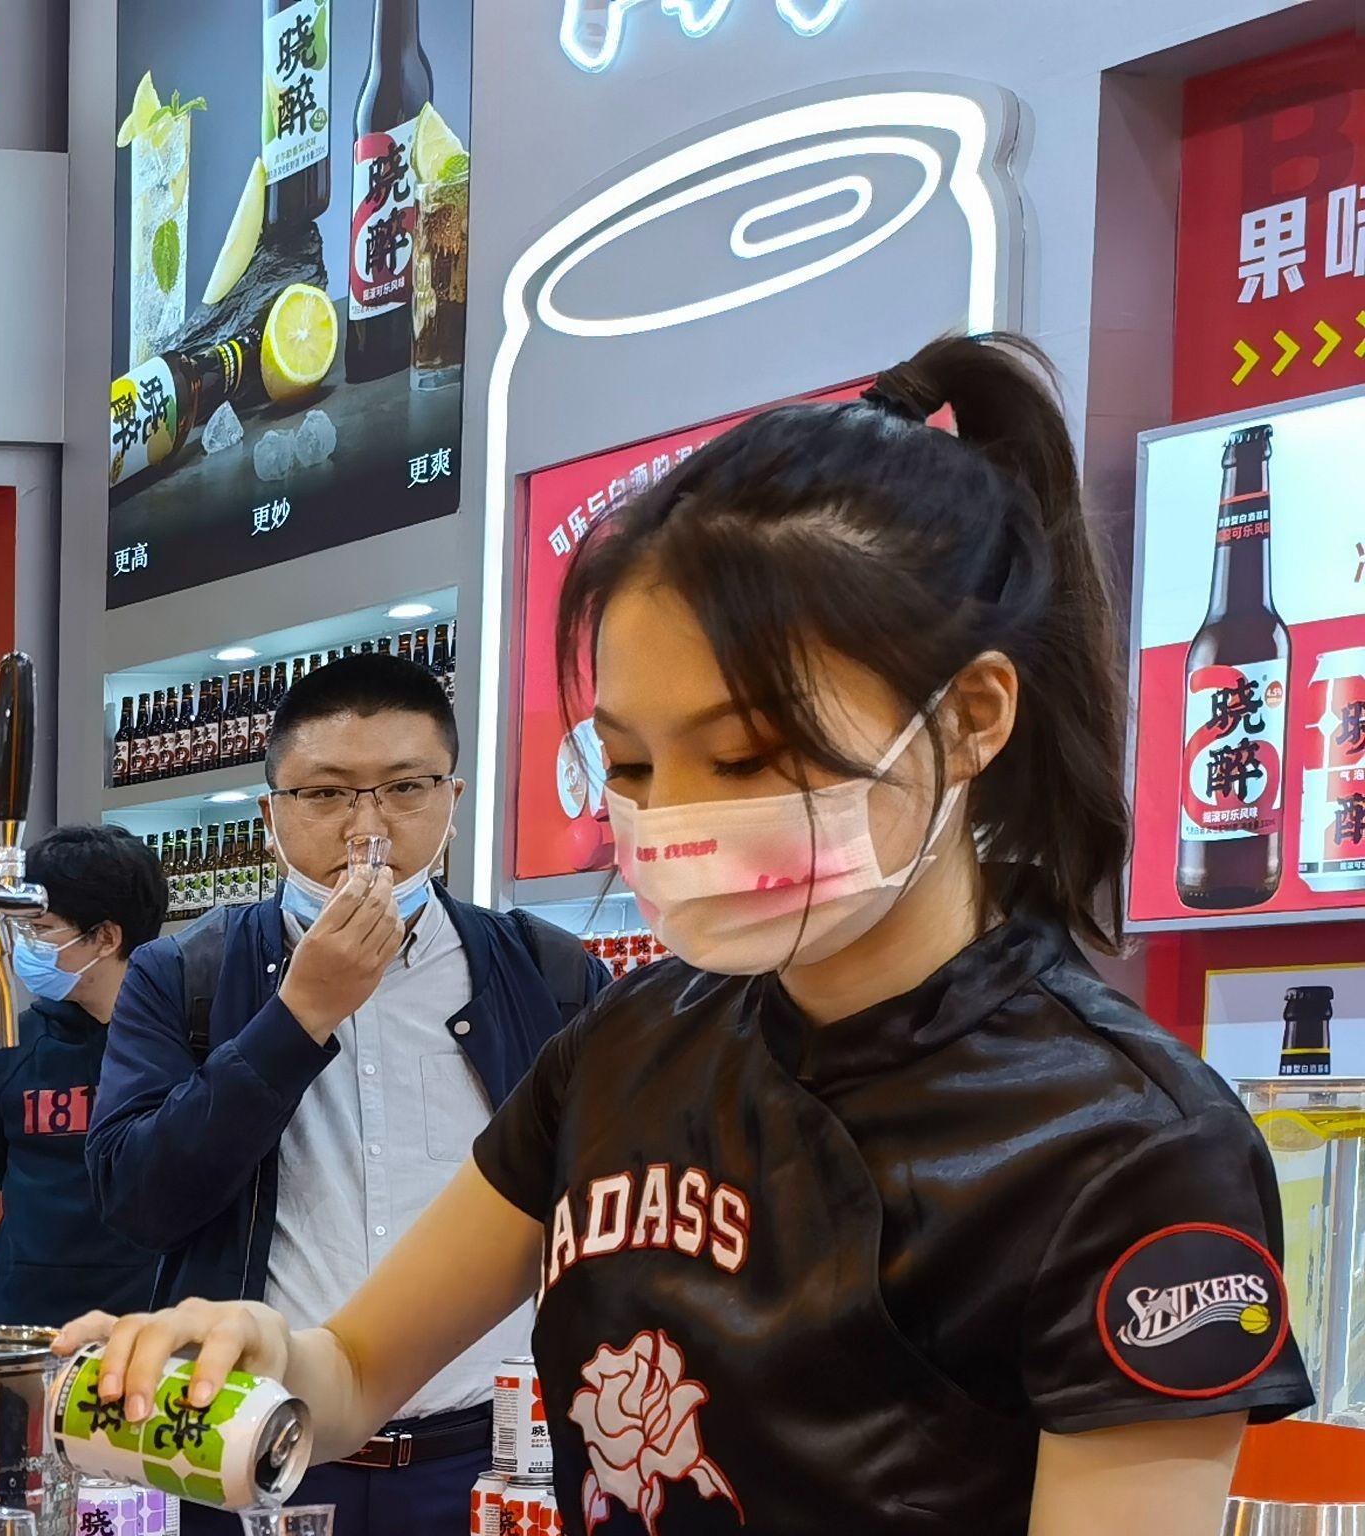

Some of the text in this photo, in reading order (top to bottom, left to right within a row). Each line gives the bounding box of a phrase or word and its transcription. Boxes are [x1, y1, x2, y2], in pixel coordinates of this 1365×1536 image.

[276, 14, 318, 140] 晓醉
[407, 447, 453, 489] 更爽
[251, 498, 291, 536] 更妙
[114, 542, 149, 577] 更高
[1206, 677, 1265, 801] 晓醉
[541, 1164, 750, 1290] ADASS
